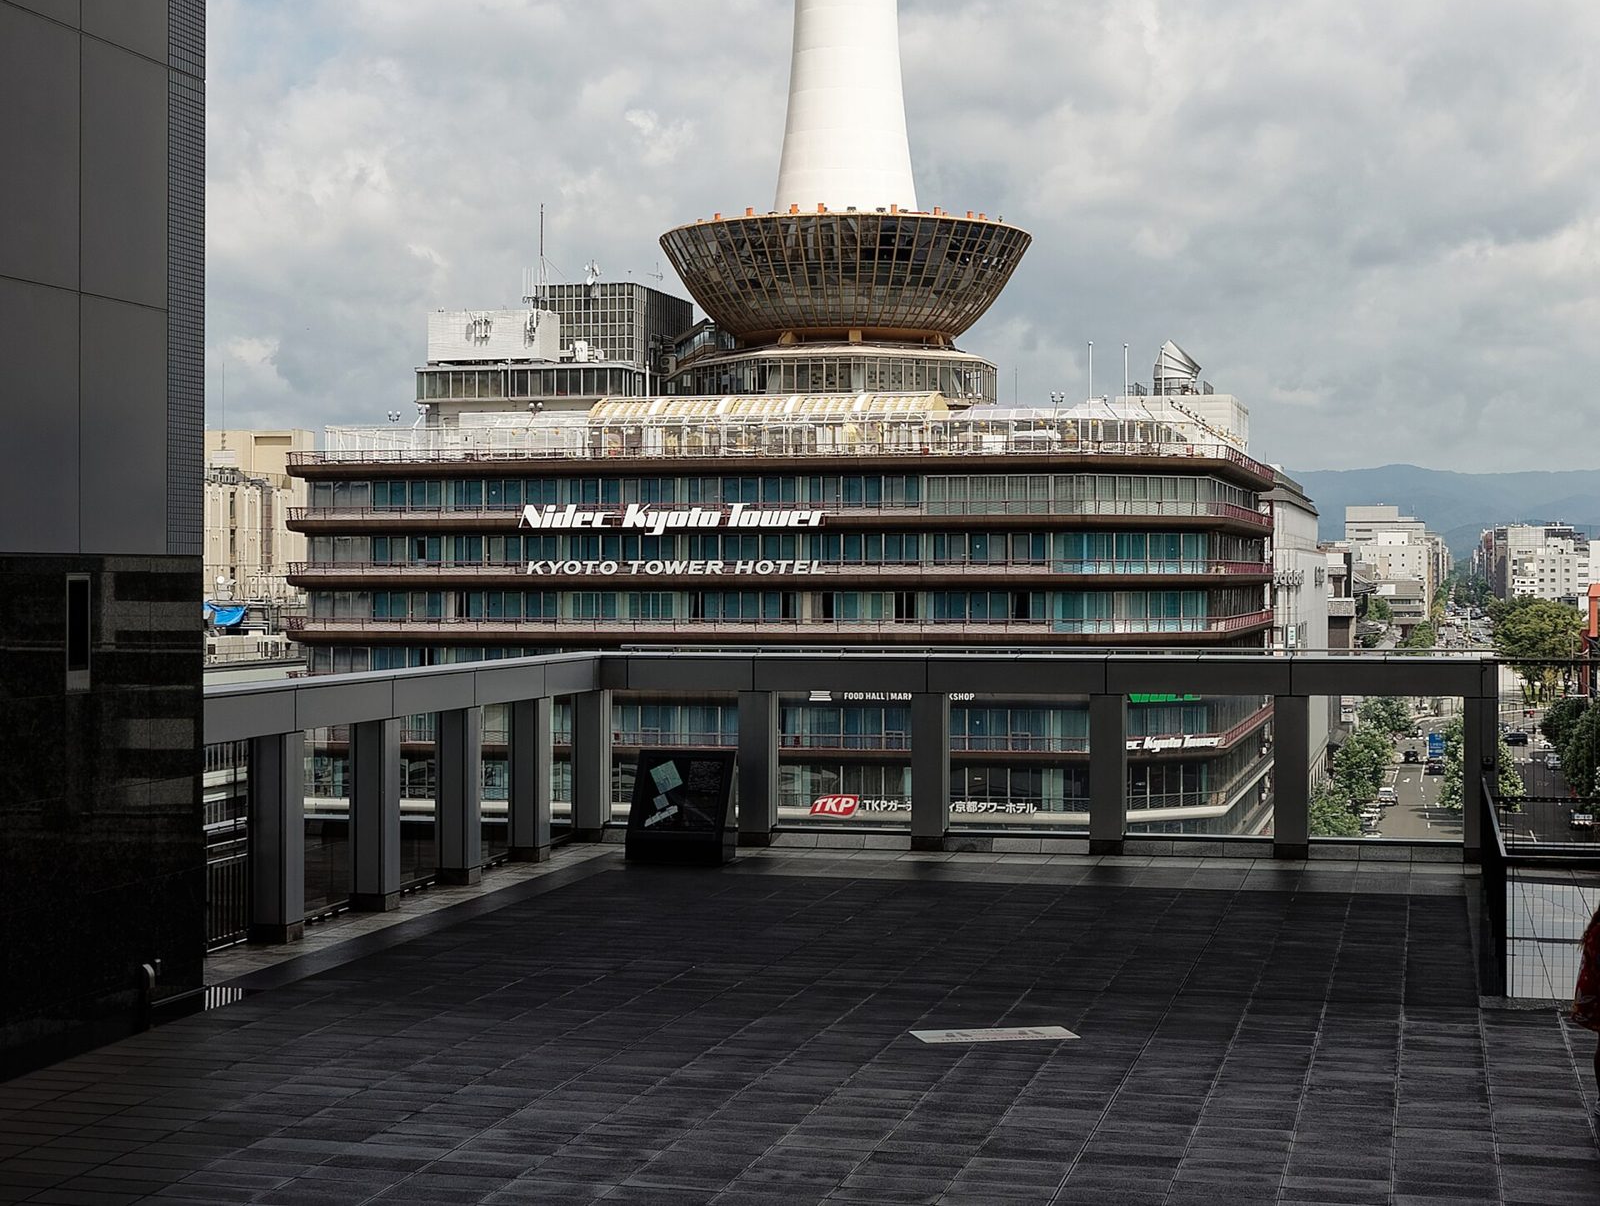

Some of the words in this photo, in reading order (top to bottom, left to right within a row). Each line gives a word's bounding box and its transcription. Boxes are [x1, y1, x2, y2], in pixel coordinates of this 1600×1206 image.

[519, 504, 616, 529] Nidec
[622, 503, 721, 535] Kyoto
[727, 502, 830, 527] Tower
[526, 560, 618, 575] KYOTO
[627, 560, 724, 575] TOWER
[734, 560, 826, 575] HOTEL
[843, 692, 864, 700] FOOD
[865, 692, 885, 700] HALL
[1143, 736, 1183, 753] Kyoto
[1183, 734, 1223, 748] Tower
[815, 797, 855, 813] TKP
